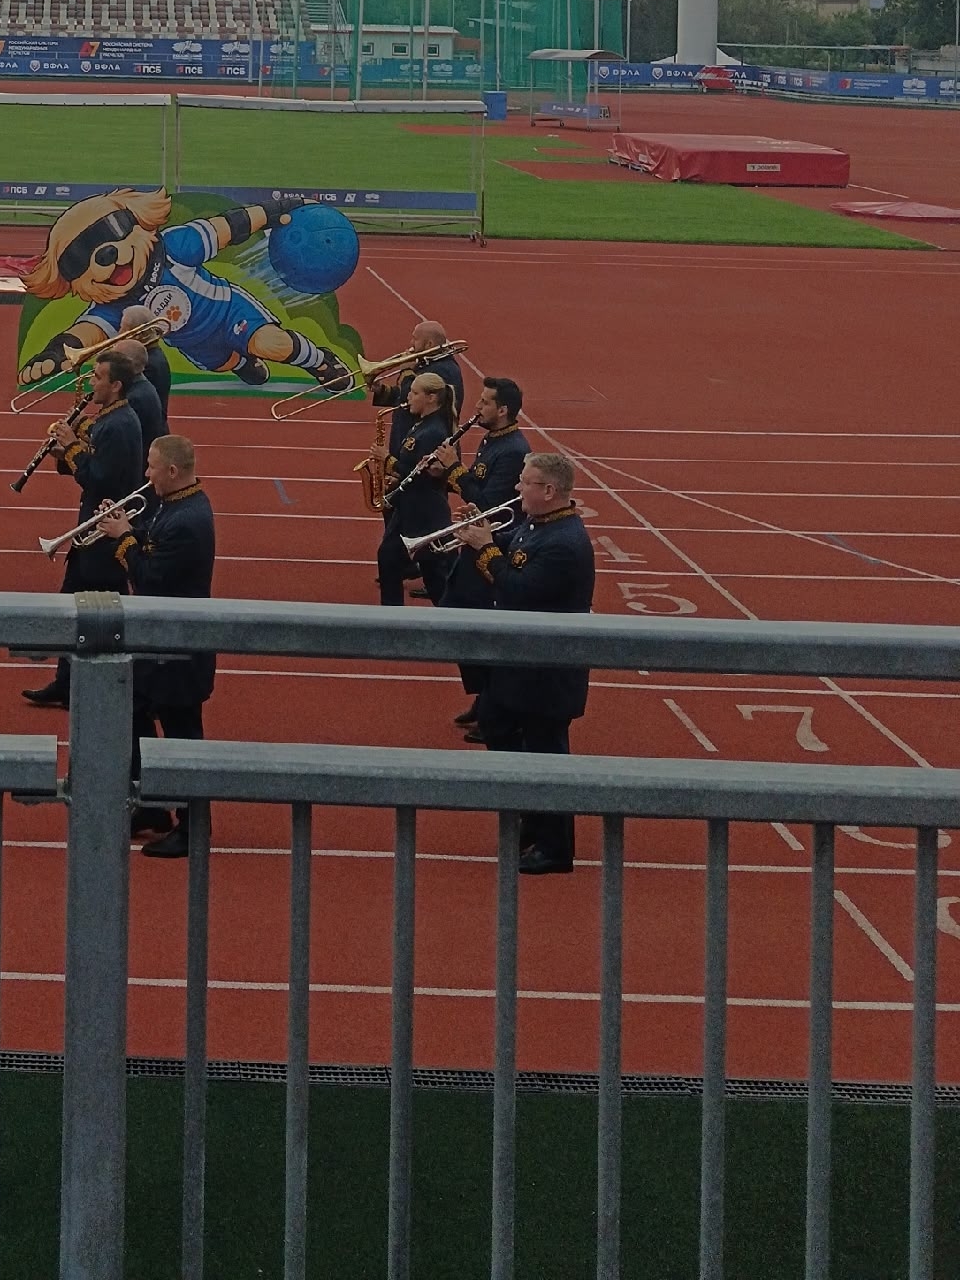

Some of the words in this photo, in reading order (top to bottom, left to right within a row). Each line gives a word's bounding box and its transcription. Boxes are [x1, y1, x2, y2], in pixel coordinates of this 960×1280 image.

[142, 65, 162, 74] ПСБ
[184, 66, 203, 75] ПСБ
[226, 66, 246, 75] ПСБ
[10, 186, 28, 194] ПСБ
[319, 193, 337, 201] ПСБ
[153, 293, 173, 317] БАДДИ
[616, 582, 698, 615] 5
[735, 704, 830, 752] 7
